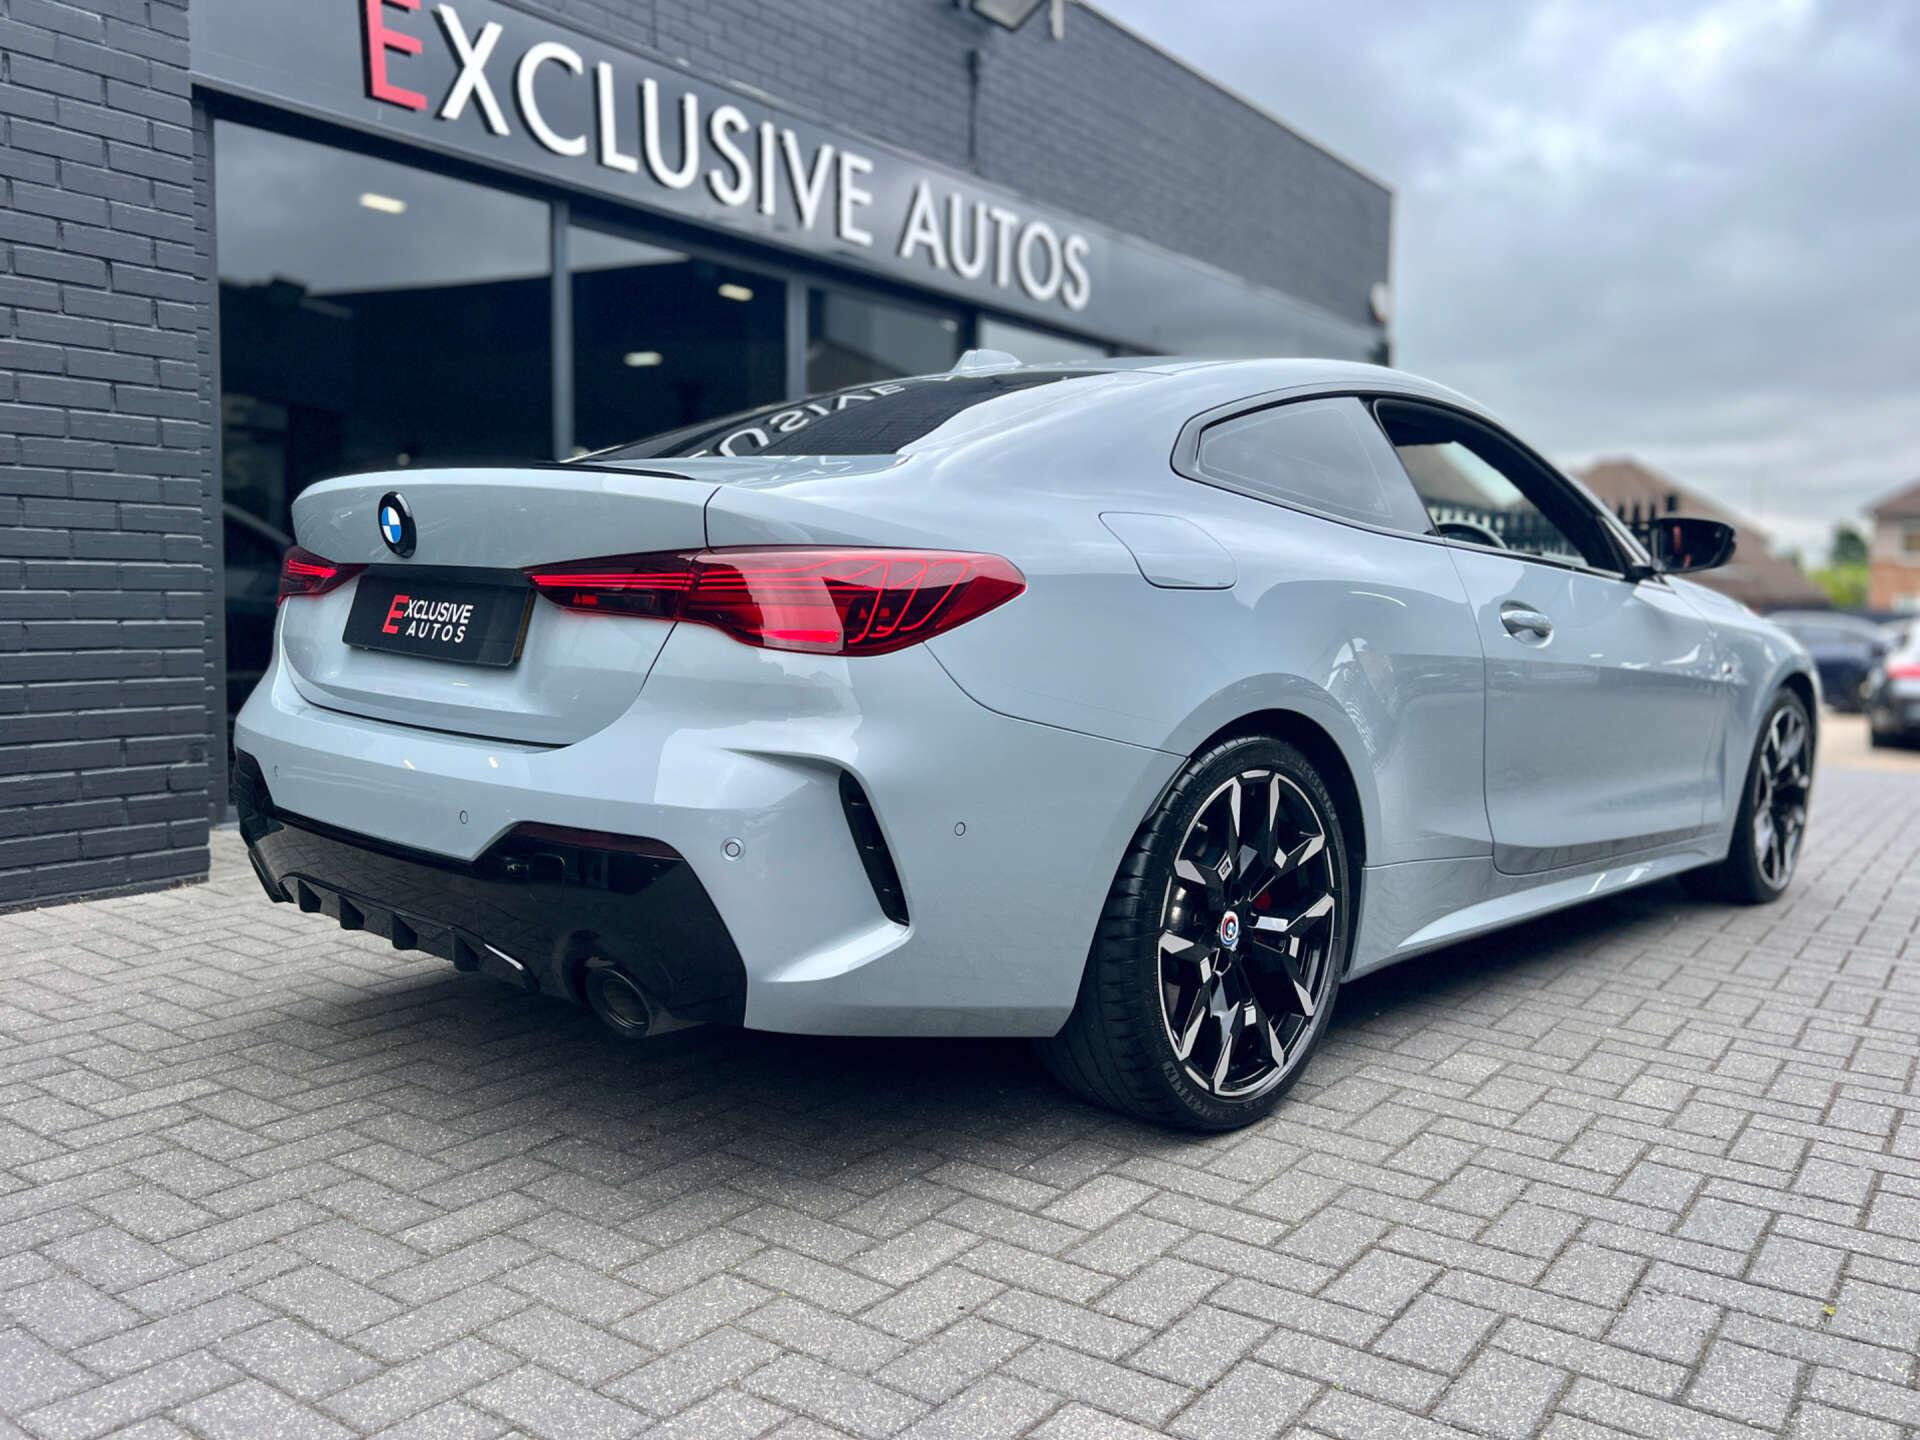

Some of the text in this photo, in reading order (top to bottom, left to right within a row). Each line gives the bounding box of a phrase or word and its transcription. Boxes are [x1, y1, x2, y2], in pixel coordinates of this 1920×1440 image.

[366, 0, 1090, 311] EXCLUSIVE AUTOS
[382, 594, 473, 635] EXCLUSIVE
[406, 621, 466, 643] AUTOS
